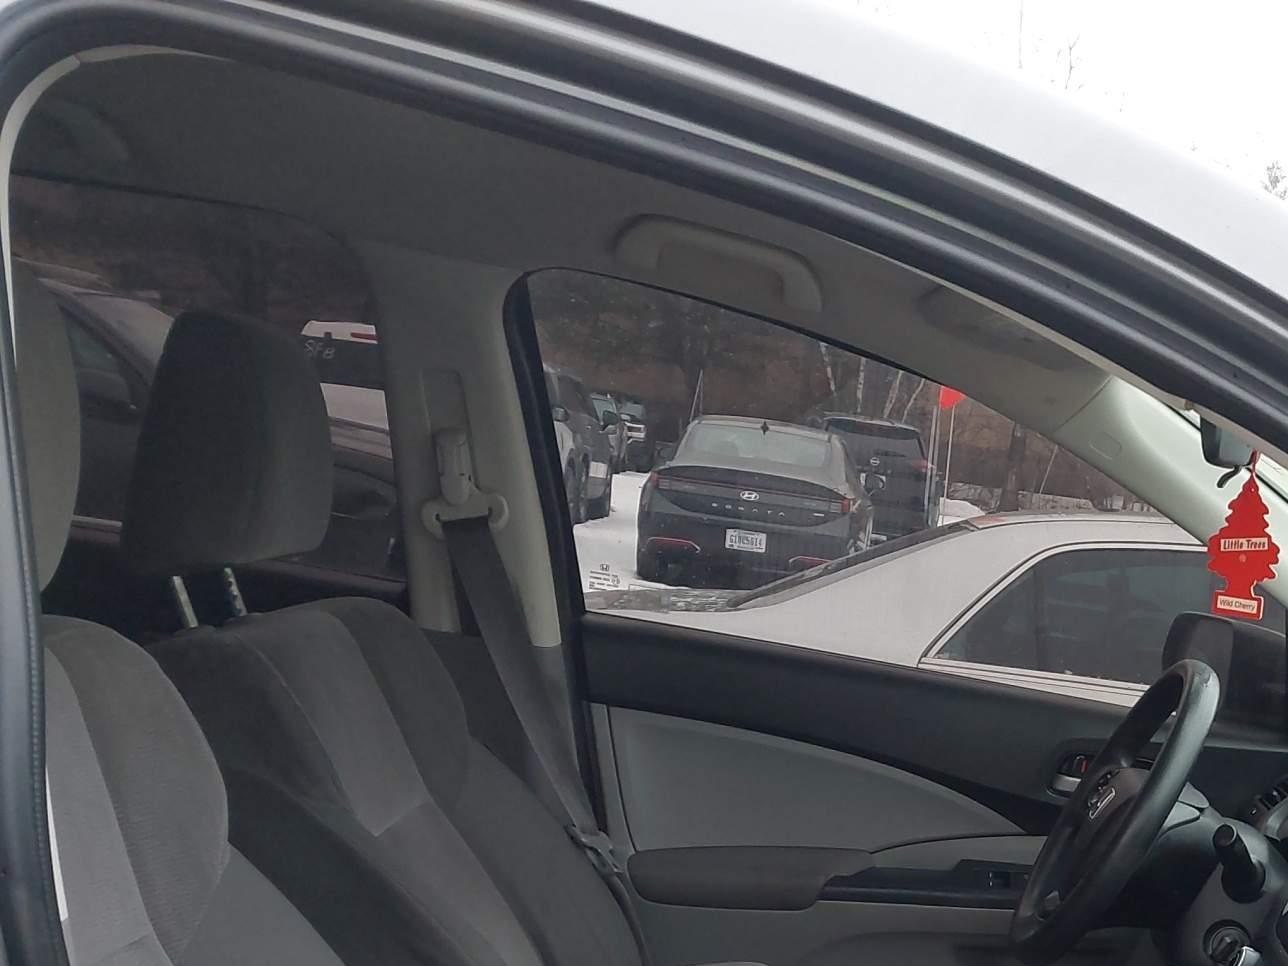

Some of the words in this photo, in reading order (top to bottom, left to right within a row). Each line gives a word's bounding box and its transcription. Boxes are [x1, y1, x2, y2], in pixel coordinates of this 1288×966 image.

[1223, 540, 1244, 550] Little
[1246, 539, 1266, 549] Trees
[1220, 599, 1233, 607] Wild
[1234, 601, 1255, 611] Cherry
